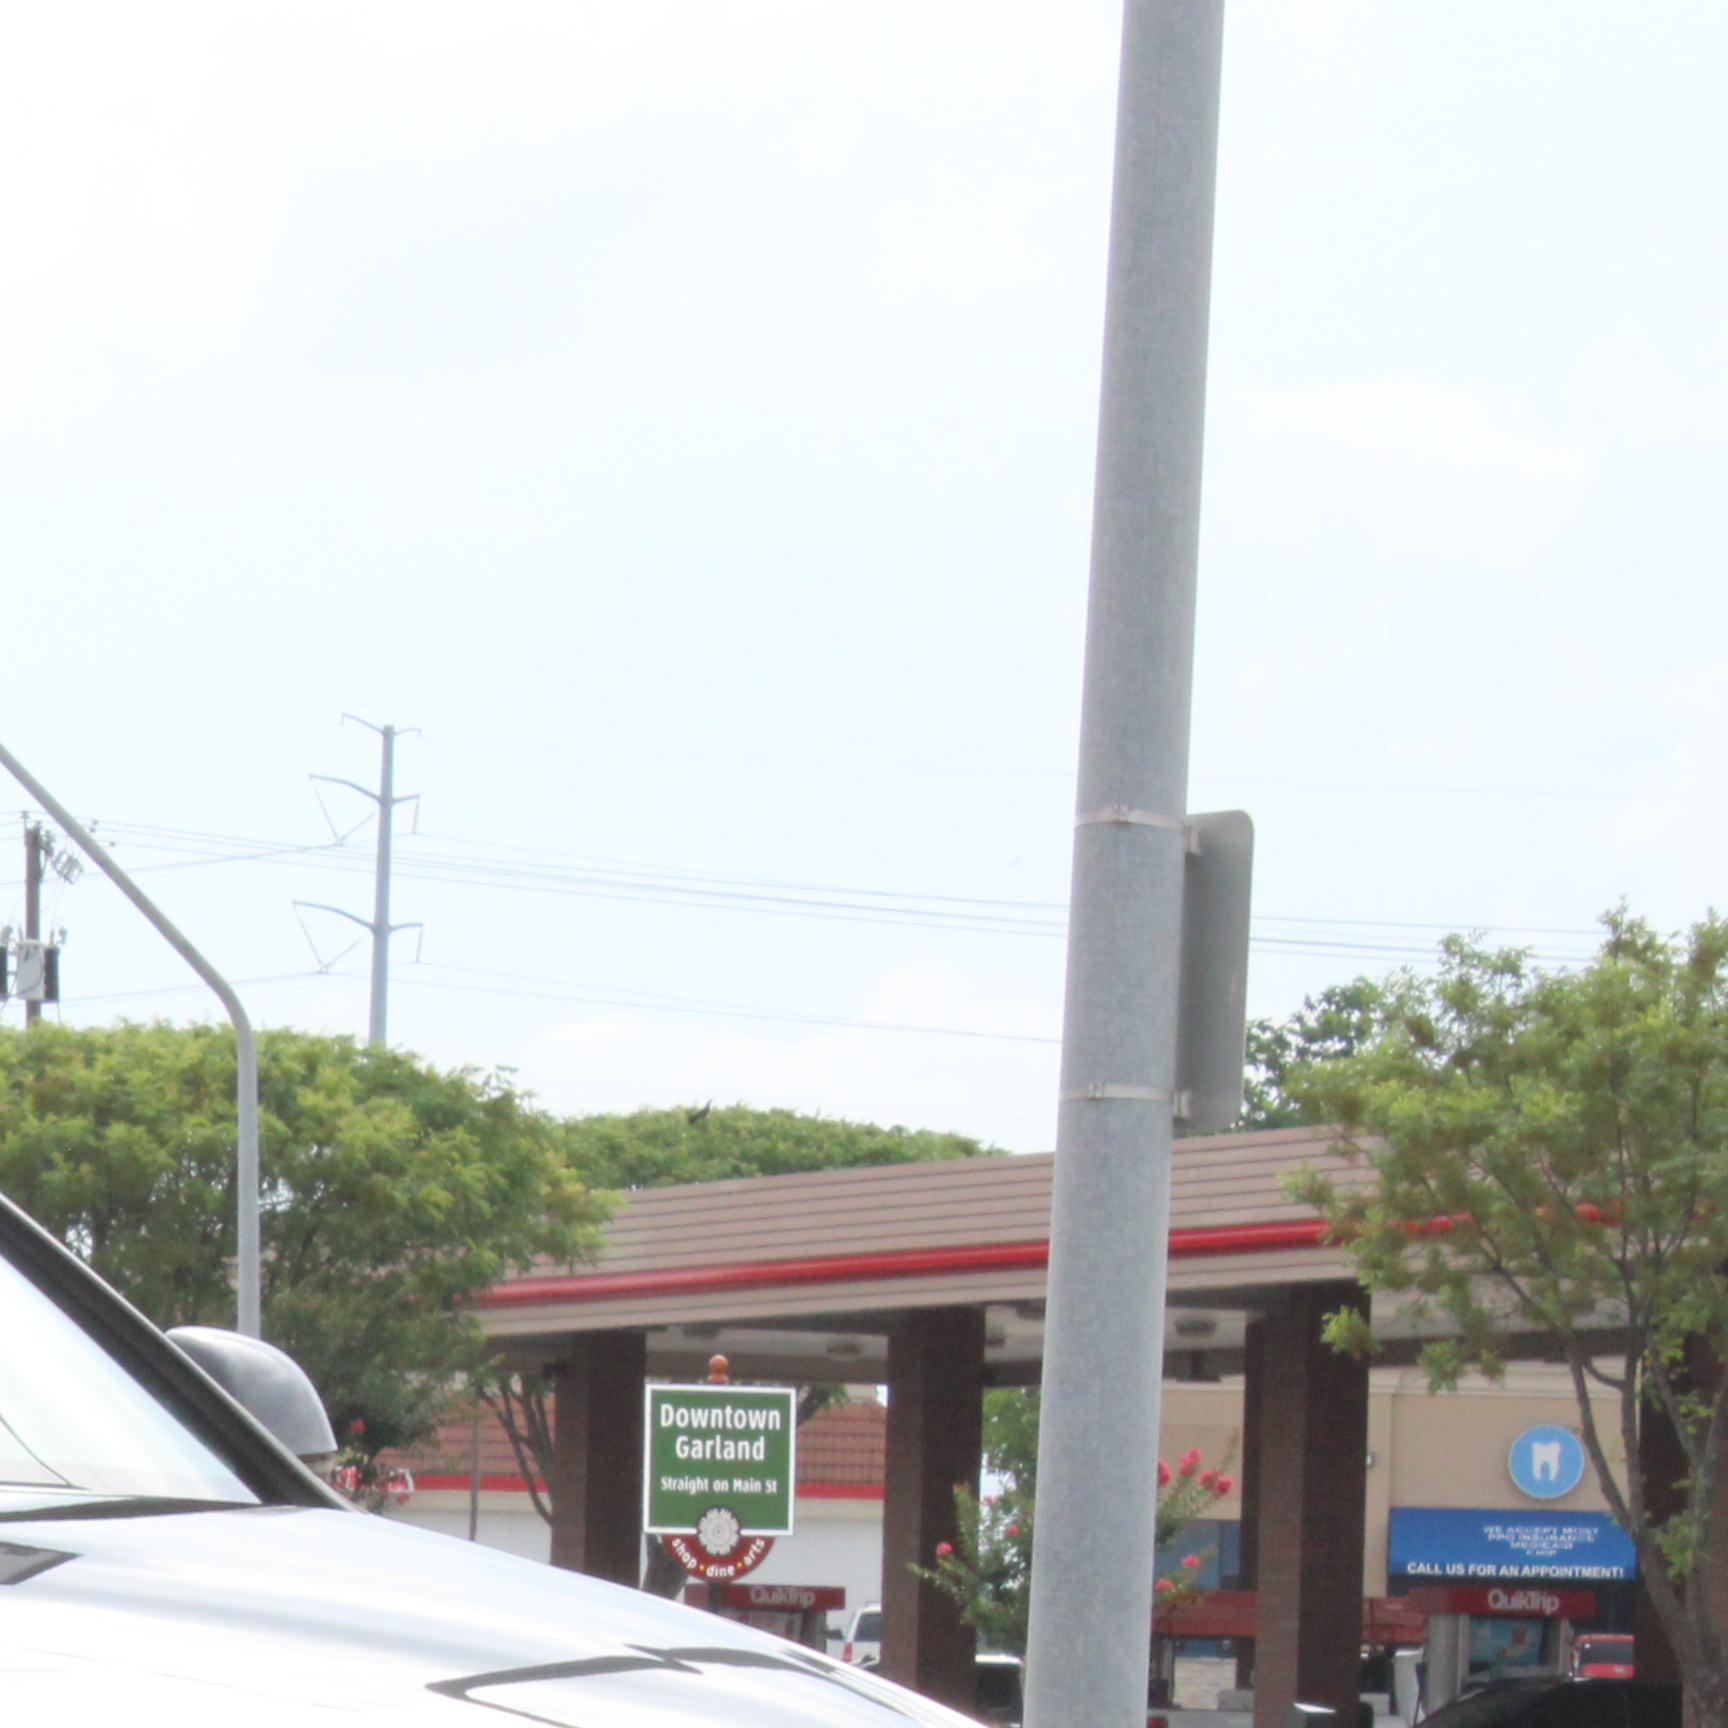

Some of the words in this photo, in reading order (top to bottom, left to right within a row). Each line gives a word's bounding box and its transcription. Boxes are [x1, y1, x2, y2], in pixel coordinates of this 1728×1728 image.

[660, 1403, 781, 1430] Downtown
[675, 1434, 765, 1461] Garland
[660, 1475, 709, 1496] Straight
[713, 1479, 729, 1492] on
[732, 1477, 762, 1492] Main
[765, 1479, 777, 1493] St
[671, 1538, 698, 1570] shop
[705, 1564, 736, 1578] dine
[743, 1537, 766, 1566] arts
[1407, 1562, 1443, 1574] CALL
[1446, 1563, 1464, 1575] US
[1468, 1564, 1495, 1576] FOR
[1499, 1565, 1519, 1577] AN
[1521, 1565, 1625, 1579] APPOINTMENT!
[749, 1585, 817, 1608] QuikTrip
[1487, 1587, 1560, 1614] QuikTrip
